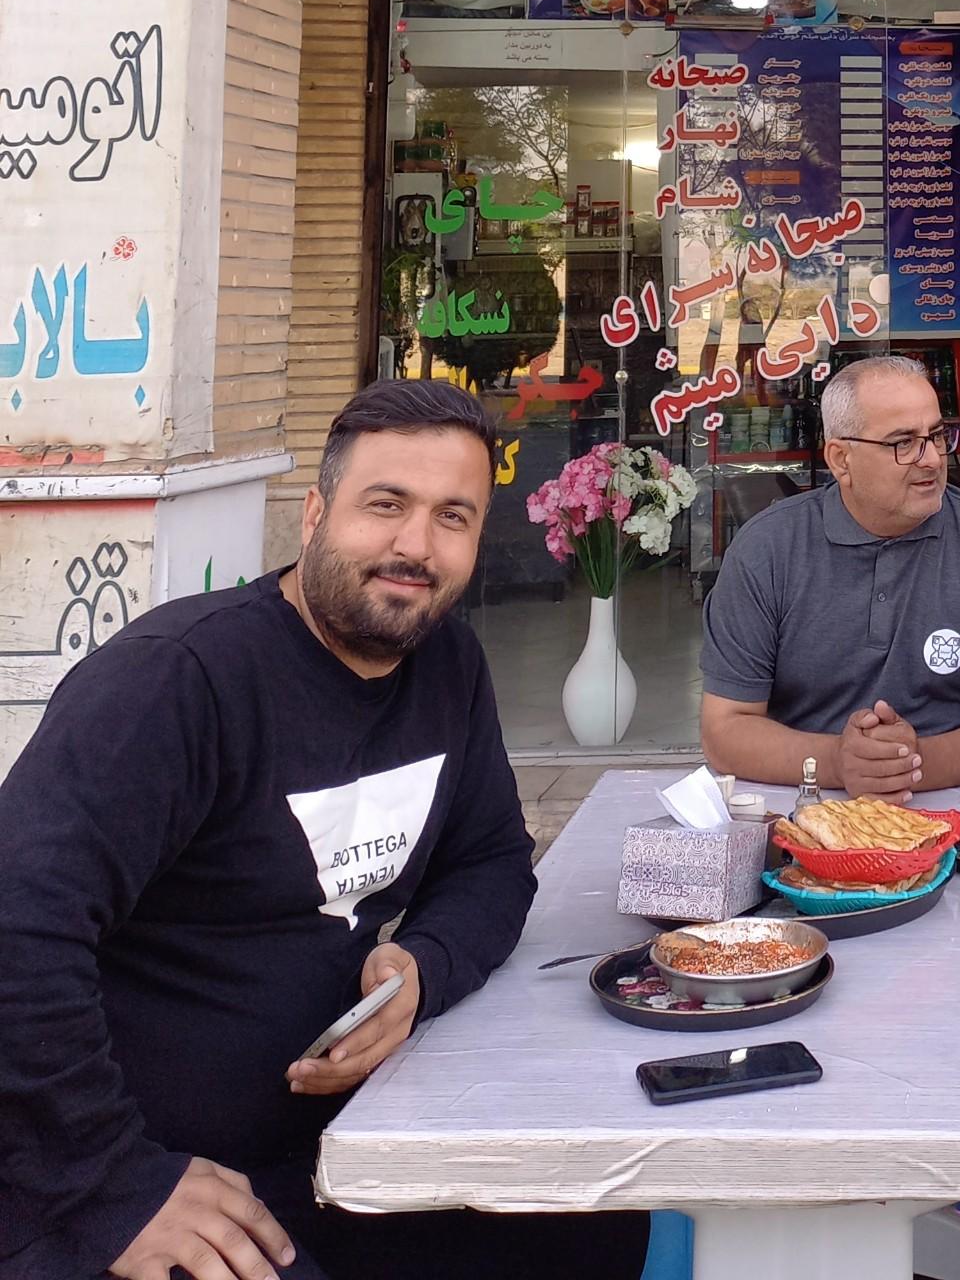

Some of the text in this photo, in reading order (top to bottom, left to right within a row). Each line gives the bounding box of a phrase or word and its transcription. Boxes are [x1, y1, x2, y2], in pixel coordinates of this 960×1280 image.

[647, 55, 748, 94] صبحانه
[659, 109, 740, 154] نهار
[424, 176, 565, 254] چای
[655, 176, 742, 218] شام
[600, 200, 865, 346] صبحانه سرای
[757, 295, 879, 380] دایی
[651, 348, 741, 436] میثم
[330, 831, 408, 869] BOTTEGA
